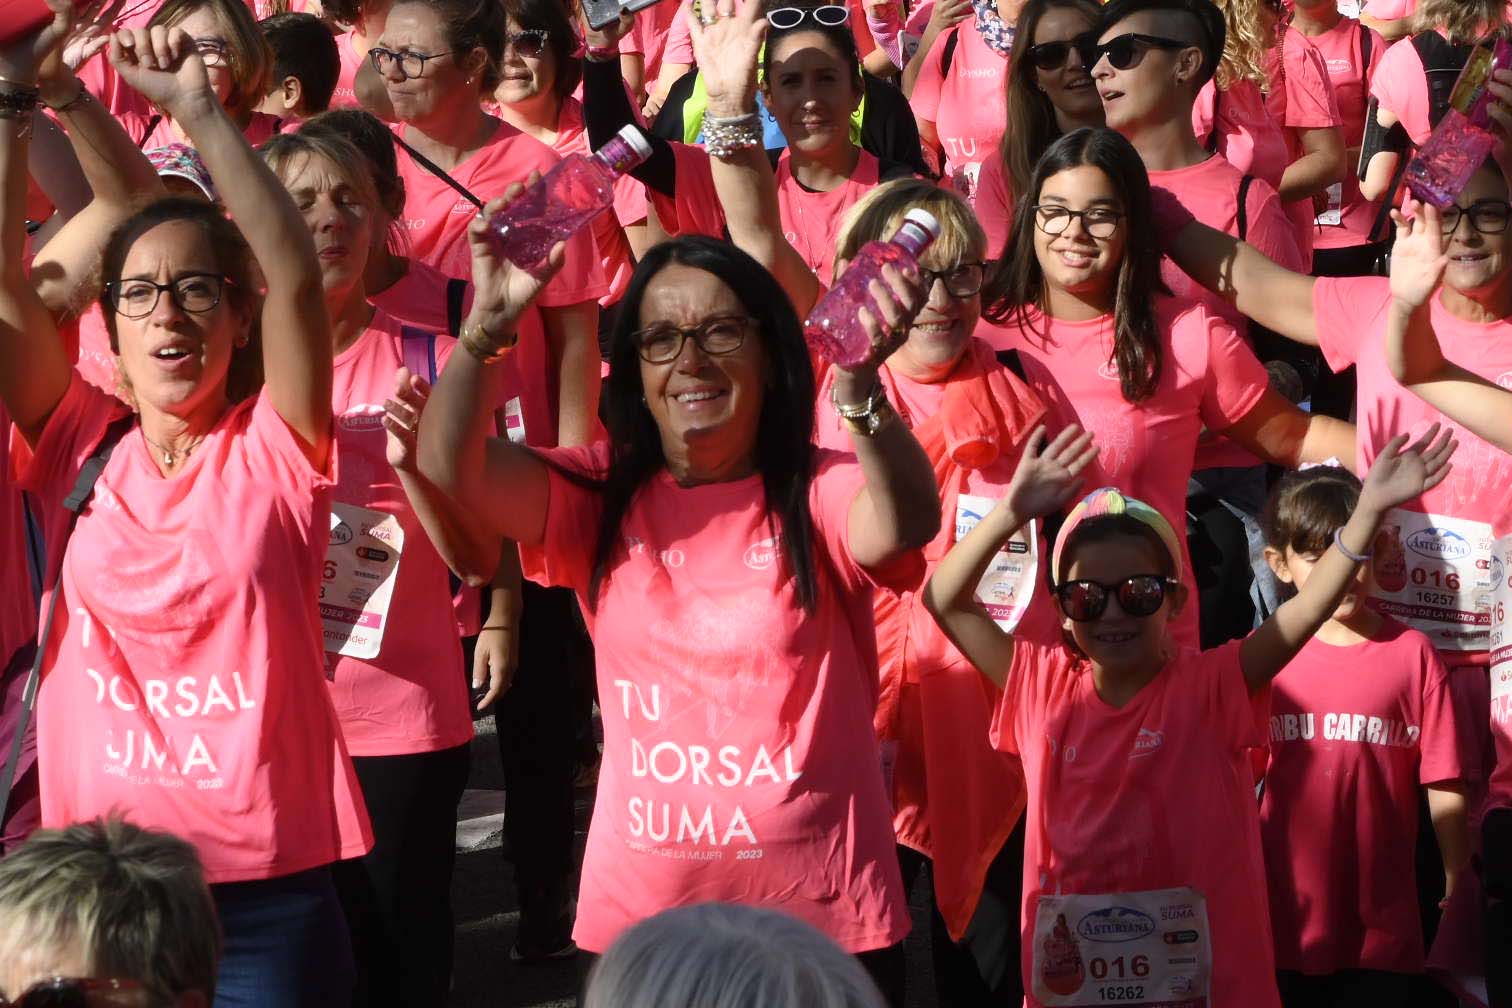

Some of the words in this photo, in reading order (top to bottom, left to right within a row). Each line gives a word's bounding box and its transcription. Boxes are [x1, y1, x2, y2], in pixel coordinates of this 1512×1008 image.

[947, 137, 977, 157] TU
[1411, 534, 1467, 556] ASTURIANA
[322, 561, 338, 580] 6
[1410, 567, 1461, 591] 016
[1415, 590, 1456, 607] 16257
[323, 630, 368, 646] antander
[613, 679, 660, 721] TU
[631, 736, 803, 787] DORSAL
[628, 796, 758, 846] SUMA
[736, 848, 764, 860] 2023
[1161, 908, 1195, 922] SUMA
[1083, 921, 1150, 937] ASTURIANA
[1089, 954, 1150, 980] 016
[1098, 985, 1145, 1002] 16262
